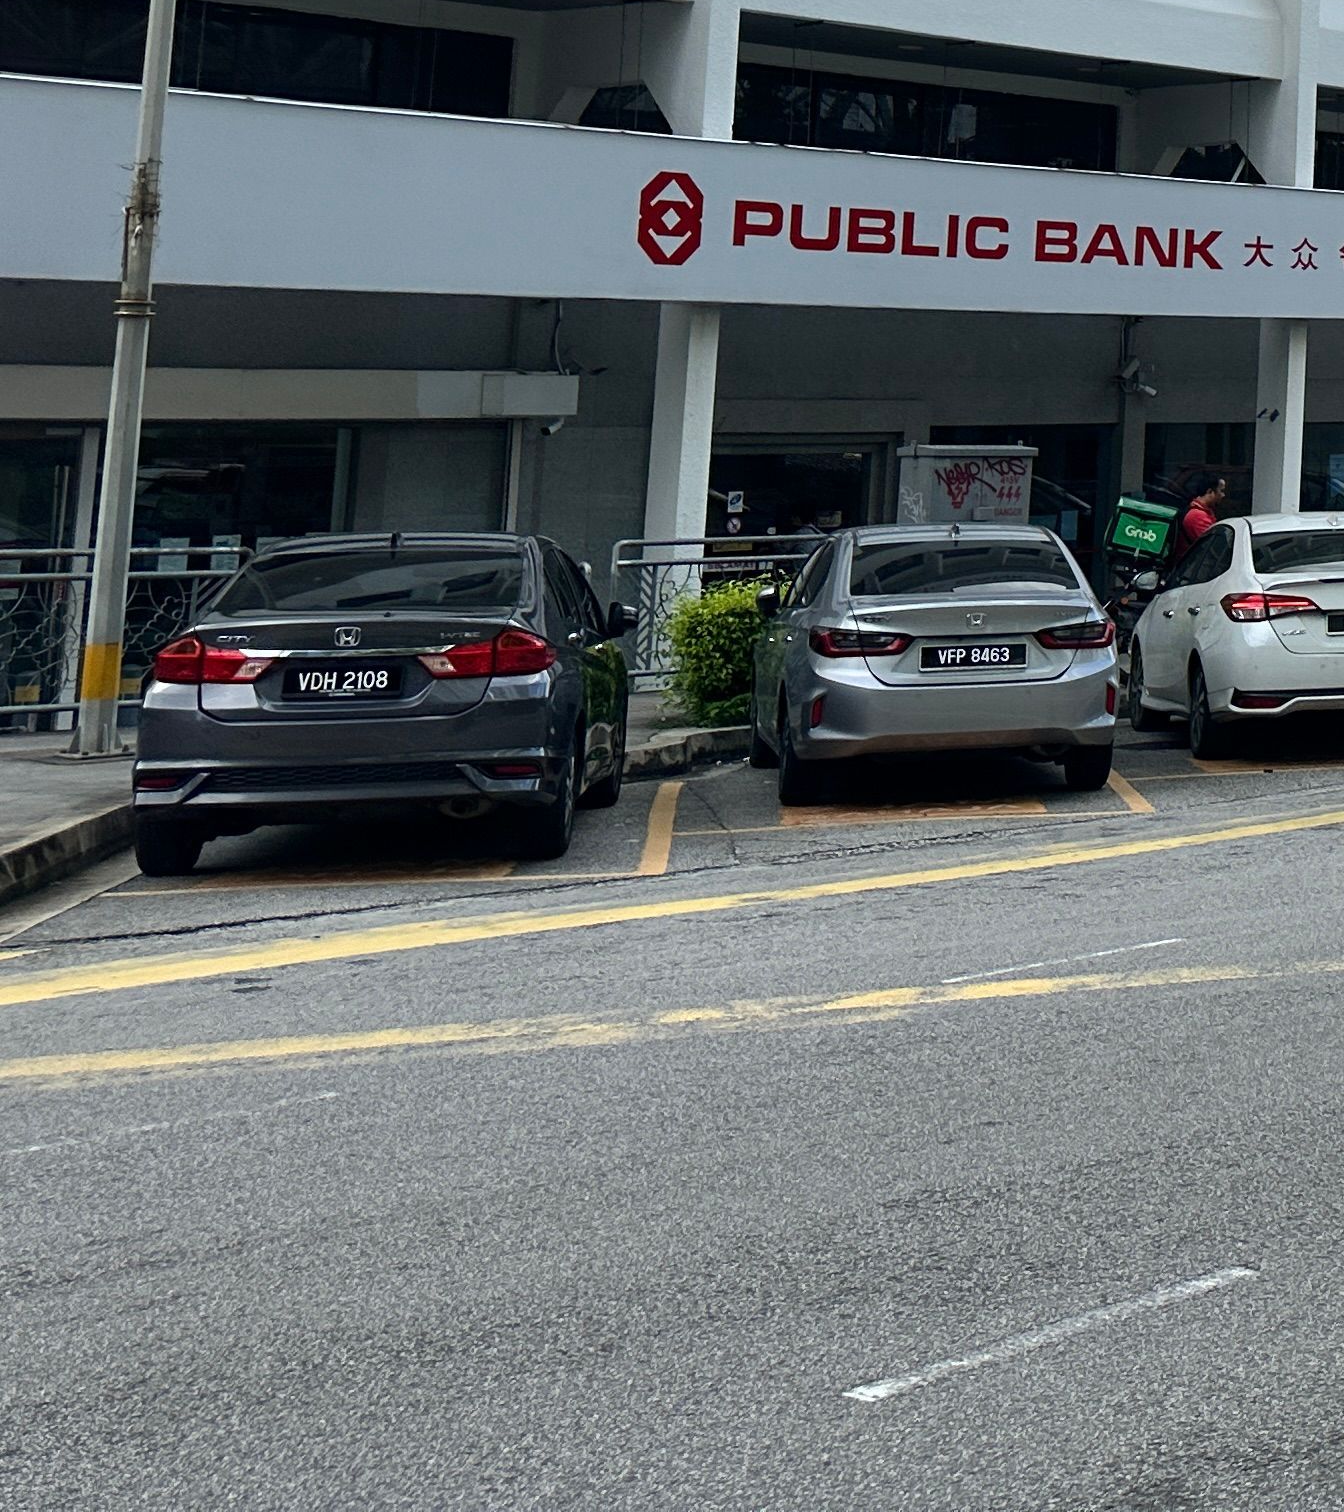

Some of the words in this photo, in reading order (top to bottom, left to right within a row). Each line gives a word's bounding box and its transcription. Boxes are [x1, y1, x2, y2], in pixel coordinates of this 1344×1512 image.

[732, 199, 1009, 260] PUBLIC
[1034, 219, 1223, 270] BANK
[1124, 524, 1157, 543] Grab
[216, 634, 257, 643] CITY
[937, 648, 967, 665] VFP
[970, 647, 1011, 663] 8463
[298, 671, 338, 692] VDH
[342, 670, 389, 690] 2108
